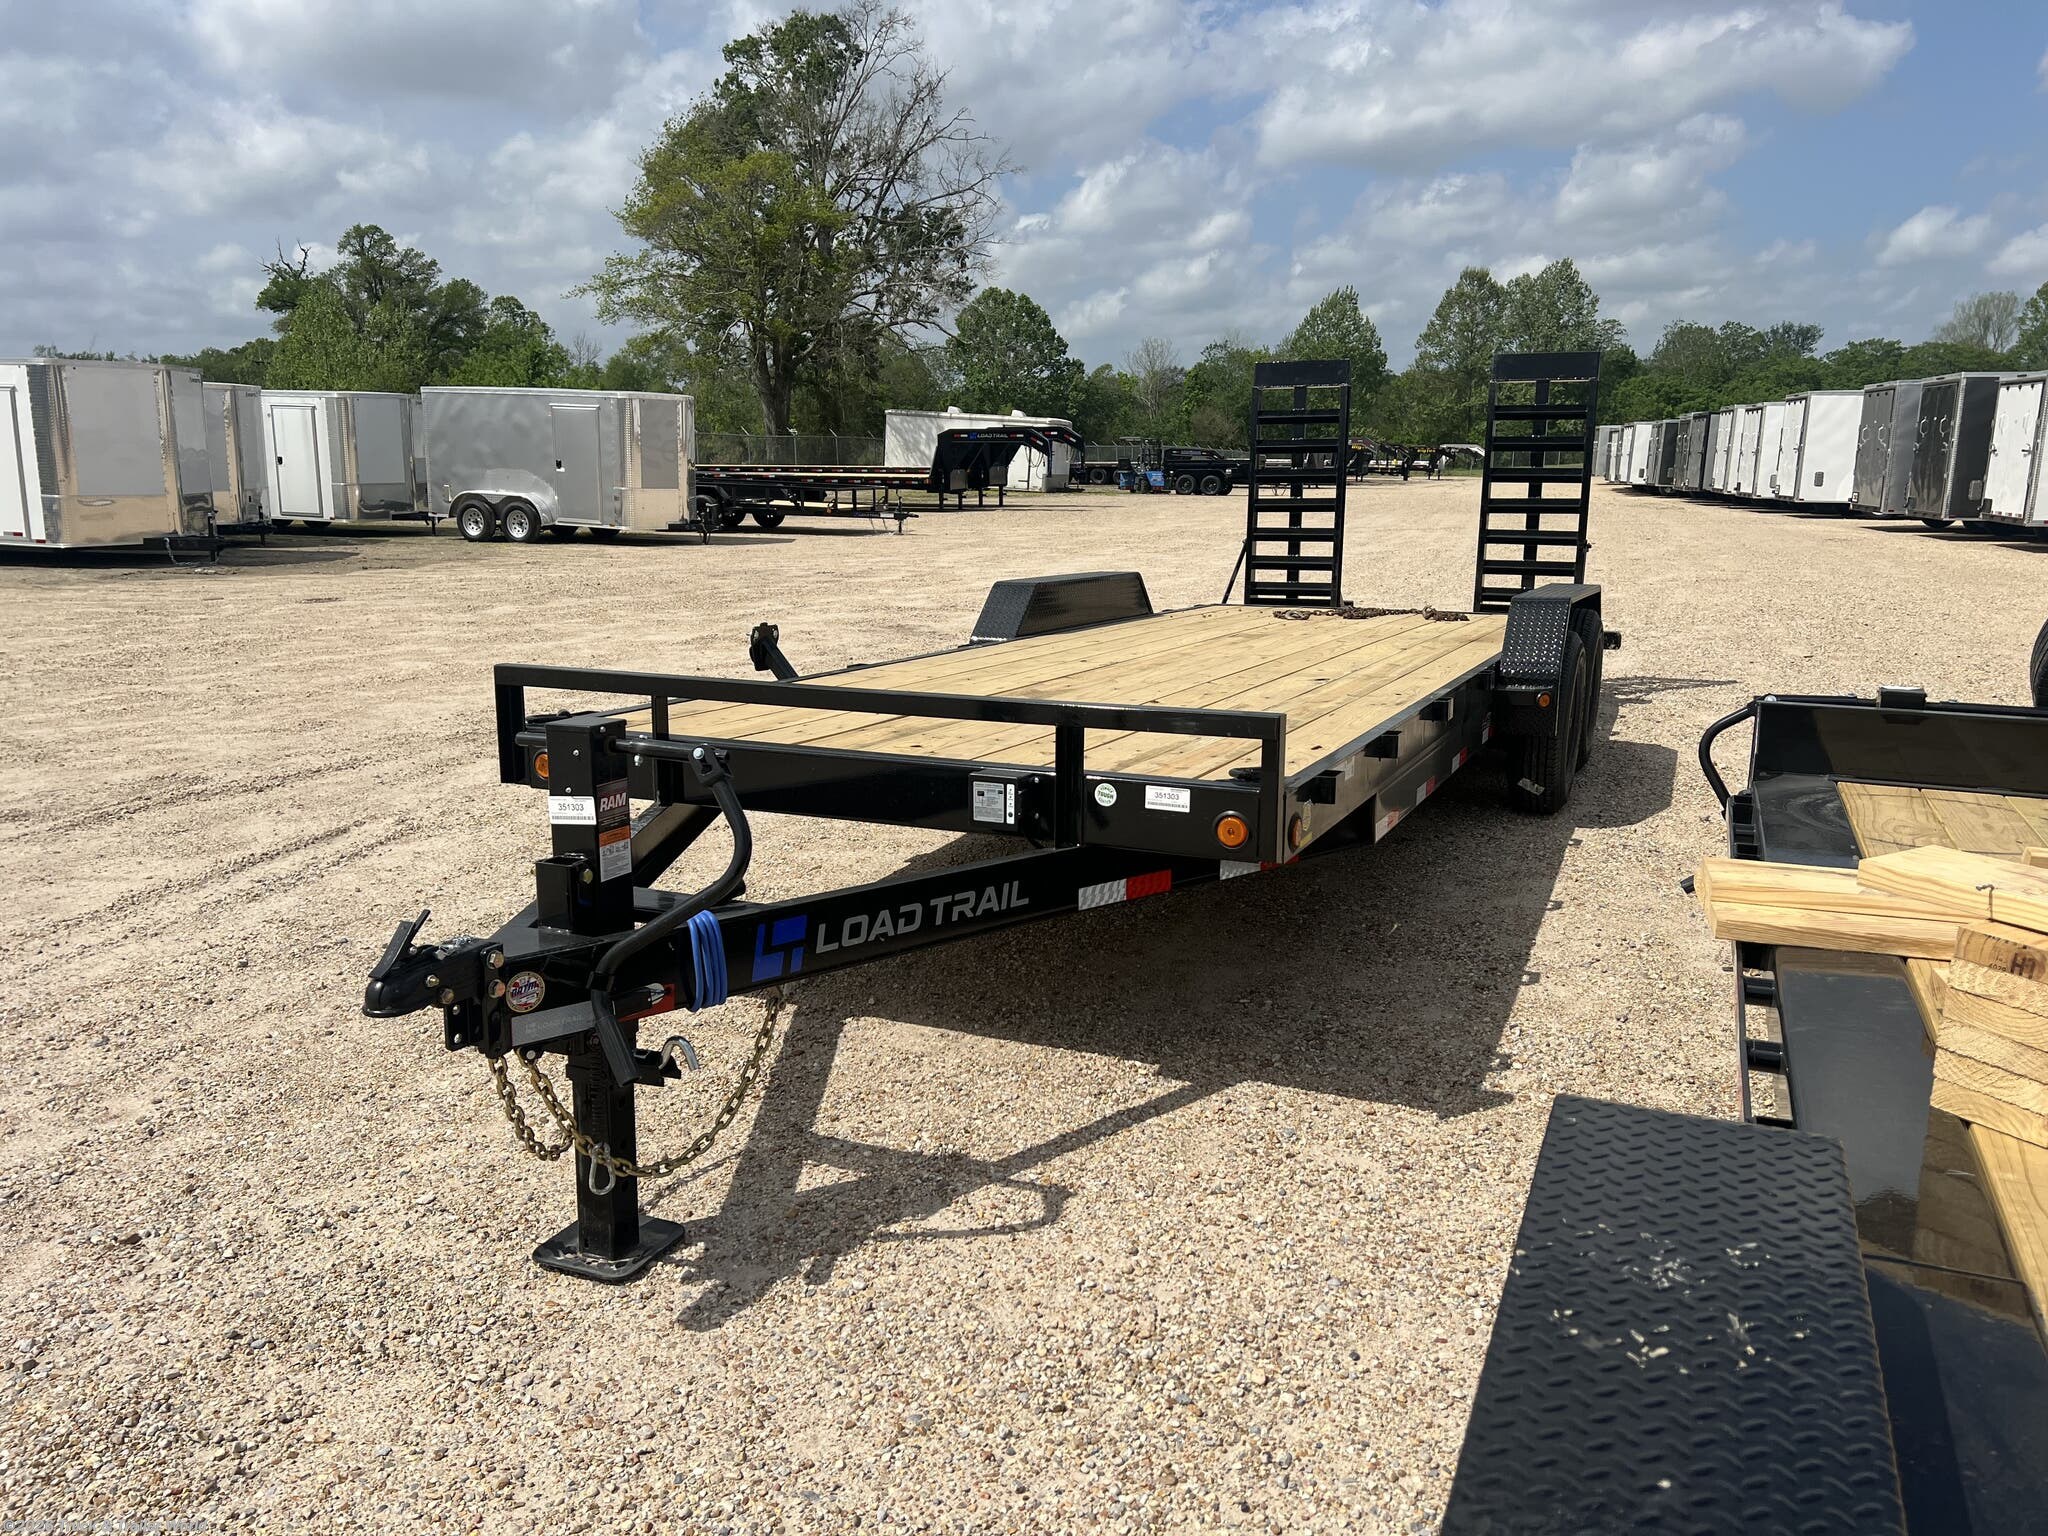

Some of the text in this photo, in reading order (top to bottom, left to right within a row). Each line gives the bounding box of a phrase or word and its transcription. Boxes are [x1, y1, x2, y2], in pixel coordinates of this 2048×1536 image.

[599, 792, 627, 812] RAM
[1154, 791, 1180, 801] 351303
[558, 802, 585, 812] 351303
[815, 902, 923, 954] LOAD
[929, 880, 1030, 926] TRAIL
